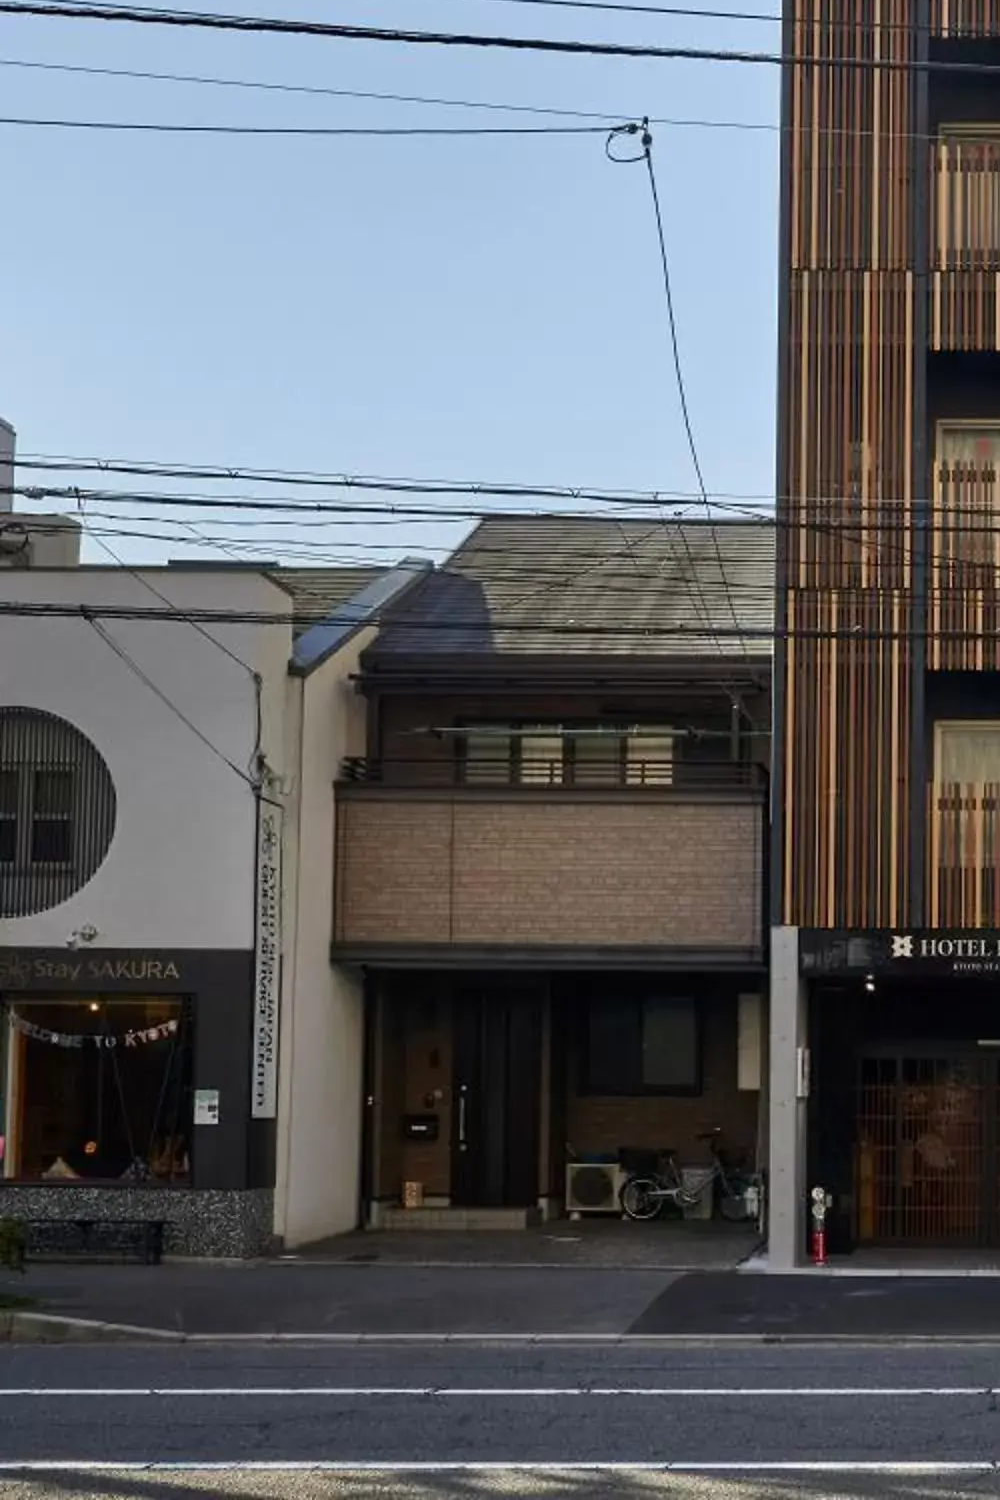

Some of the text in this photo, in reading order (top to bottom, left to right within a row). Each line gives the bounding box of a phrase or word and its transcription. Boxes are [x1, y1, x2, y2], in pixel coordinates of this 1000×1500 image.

[920, 939, 991, 957] HOTEL
[34, 958, 180, 981] Stay SAKURA
[94, 1035, 117, 1048] TO
[124, 1019, 178, 1047] KYOTO
